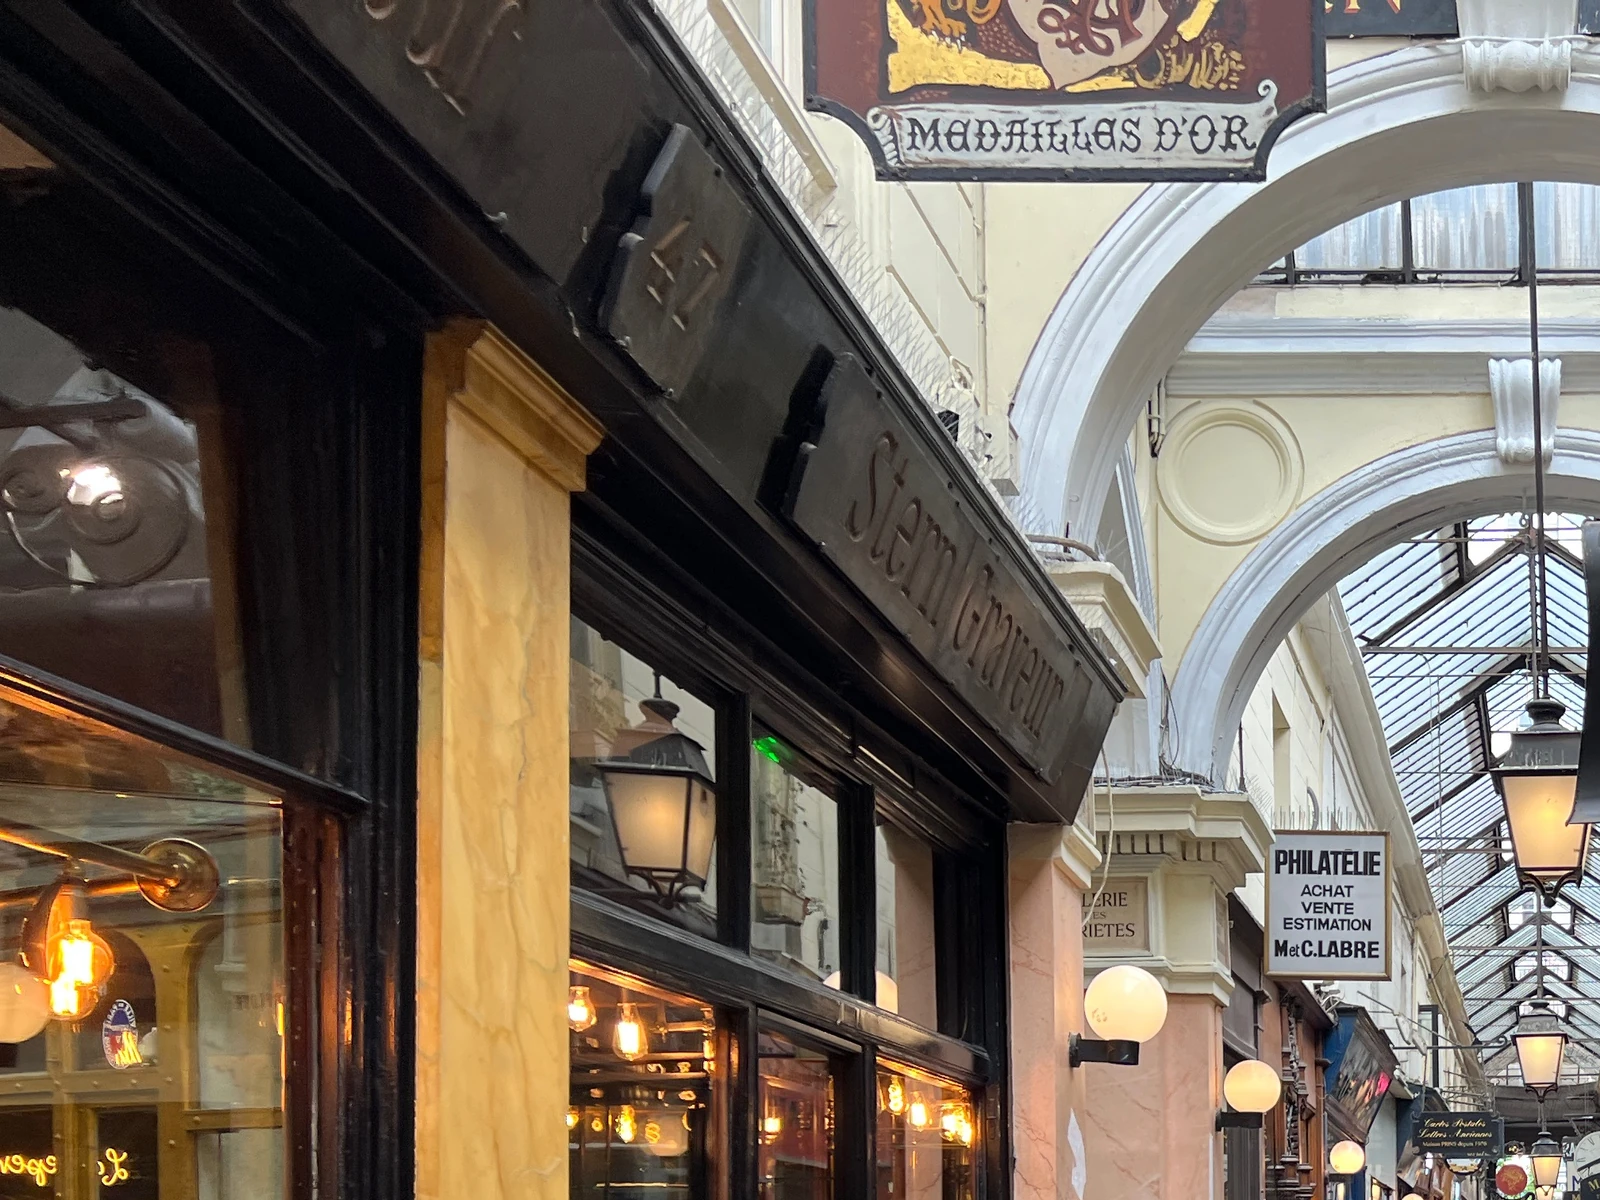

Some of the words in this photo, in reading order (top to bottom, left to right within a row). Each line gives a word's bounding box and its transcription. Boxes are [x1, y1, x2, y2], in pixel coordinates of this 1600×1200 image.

[907, 117, 1142, 154] MEDAILLES
[1154, 114, 1257, 153] D'OR
[845, 430, 958, 628] Stern
[953, 562, 1065, 739] Graveur
[1301, 885, 1354, 898] ACHAT
[1301, 902, 1354, 915] VENTE
[1283, 918, 1371, 932] ESTIMATION
